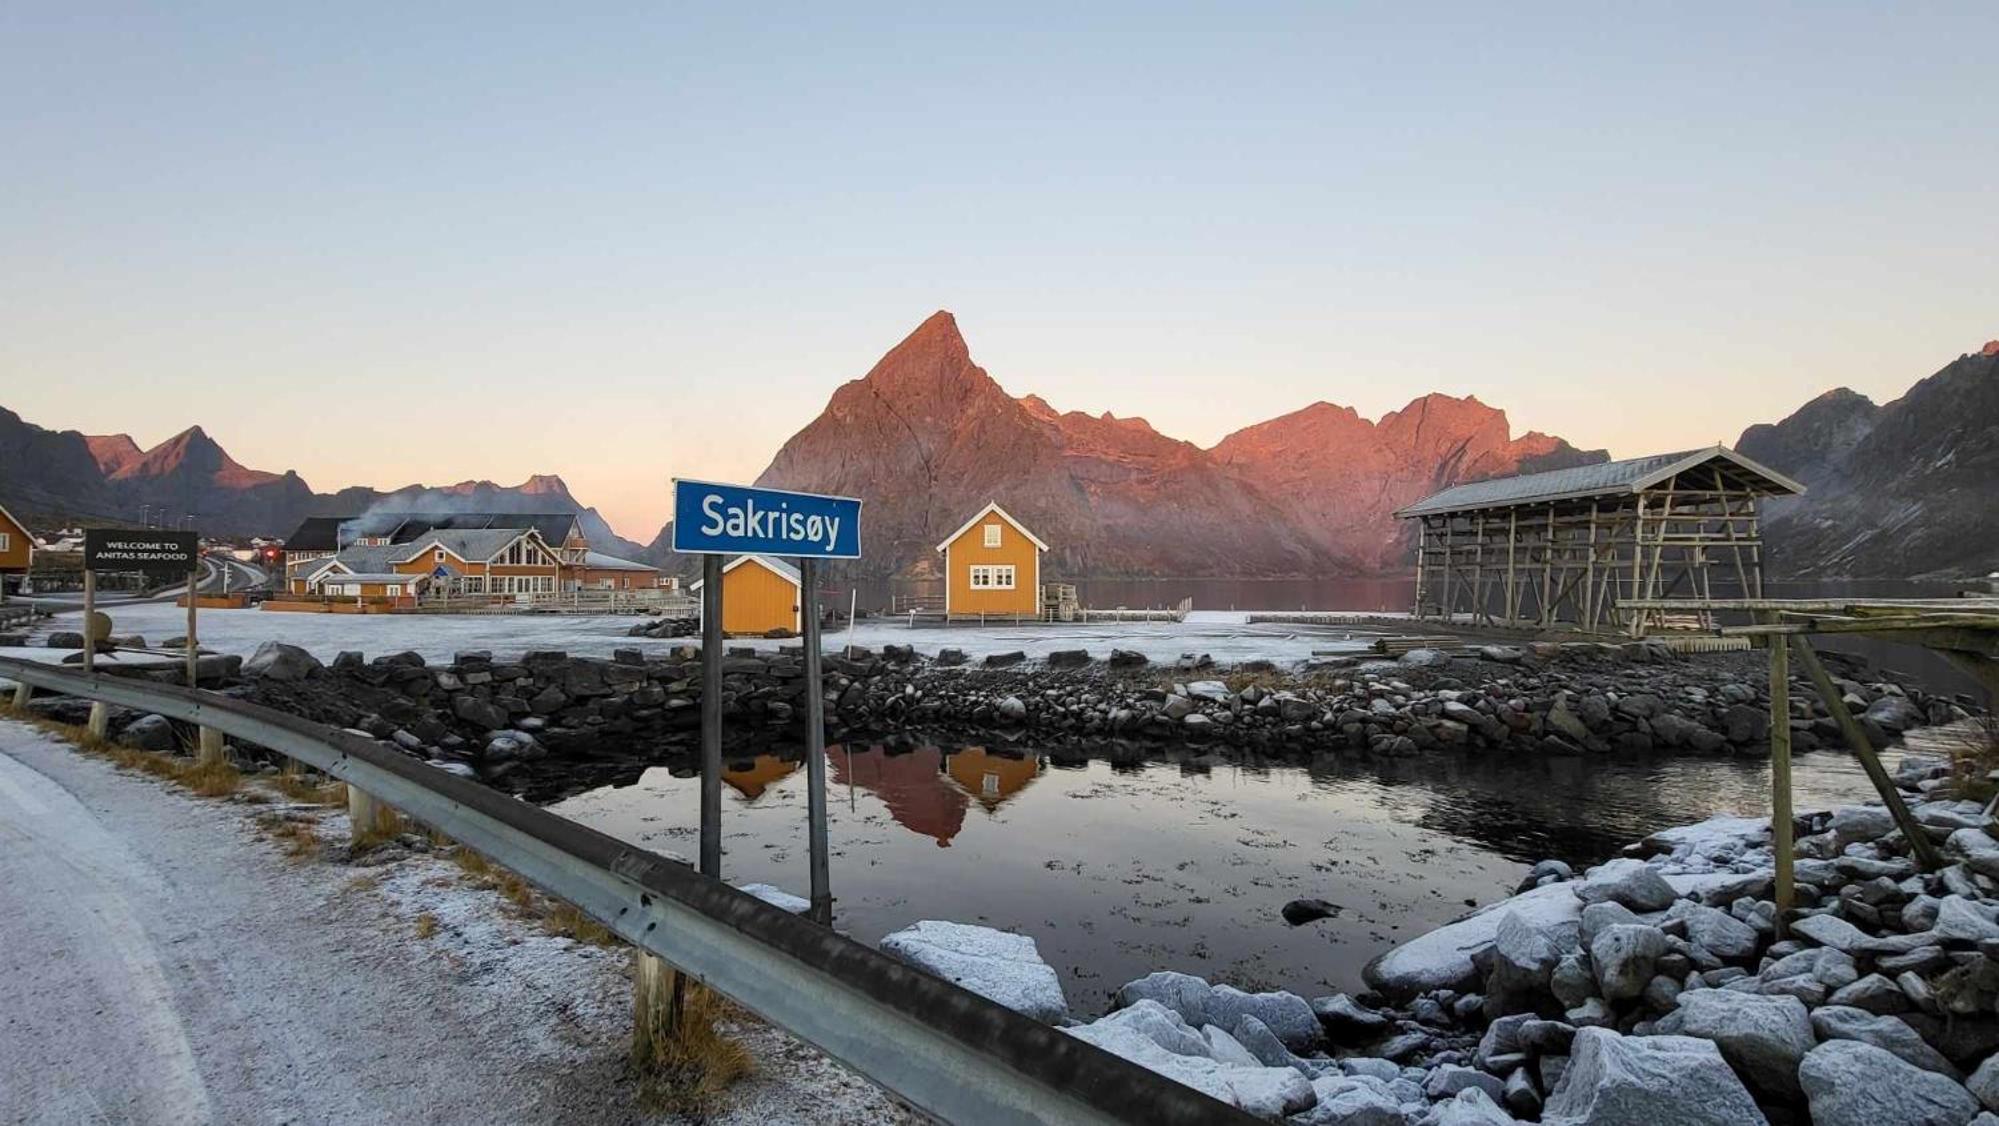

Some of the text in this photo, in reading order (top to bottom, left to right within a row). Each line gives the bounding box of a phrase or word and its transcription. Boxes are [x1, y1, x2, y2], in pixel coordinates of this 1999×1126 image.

[701, 494, 840, 551] Sakrisøy
[106, 542, 161, 550] WELCOME
[137, 552, 188, 560] SEAFOOD
